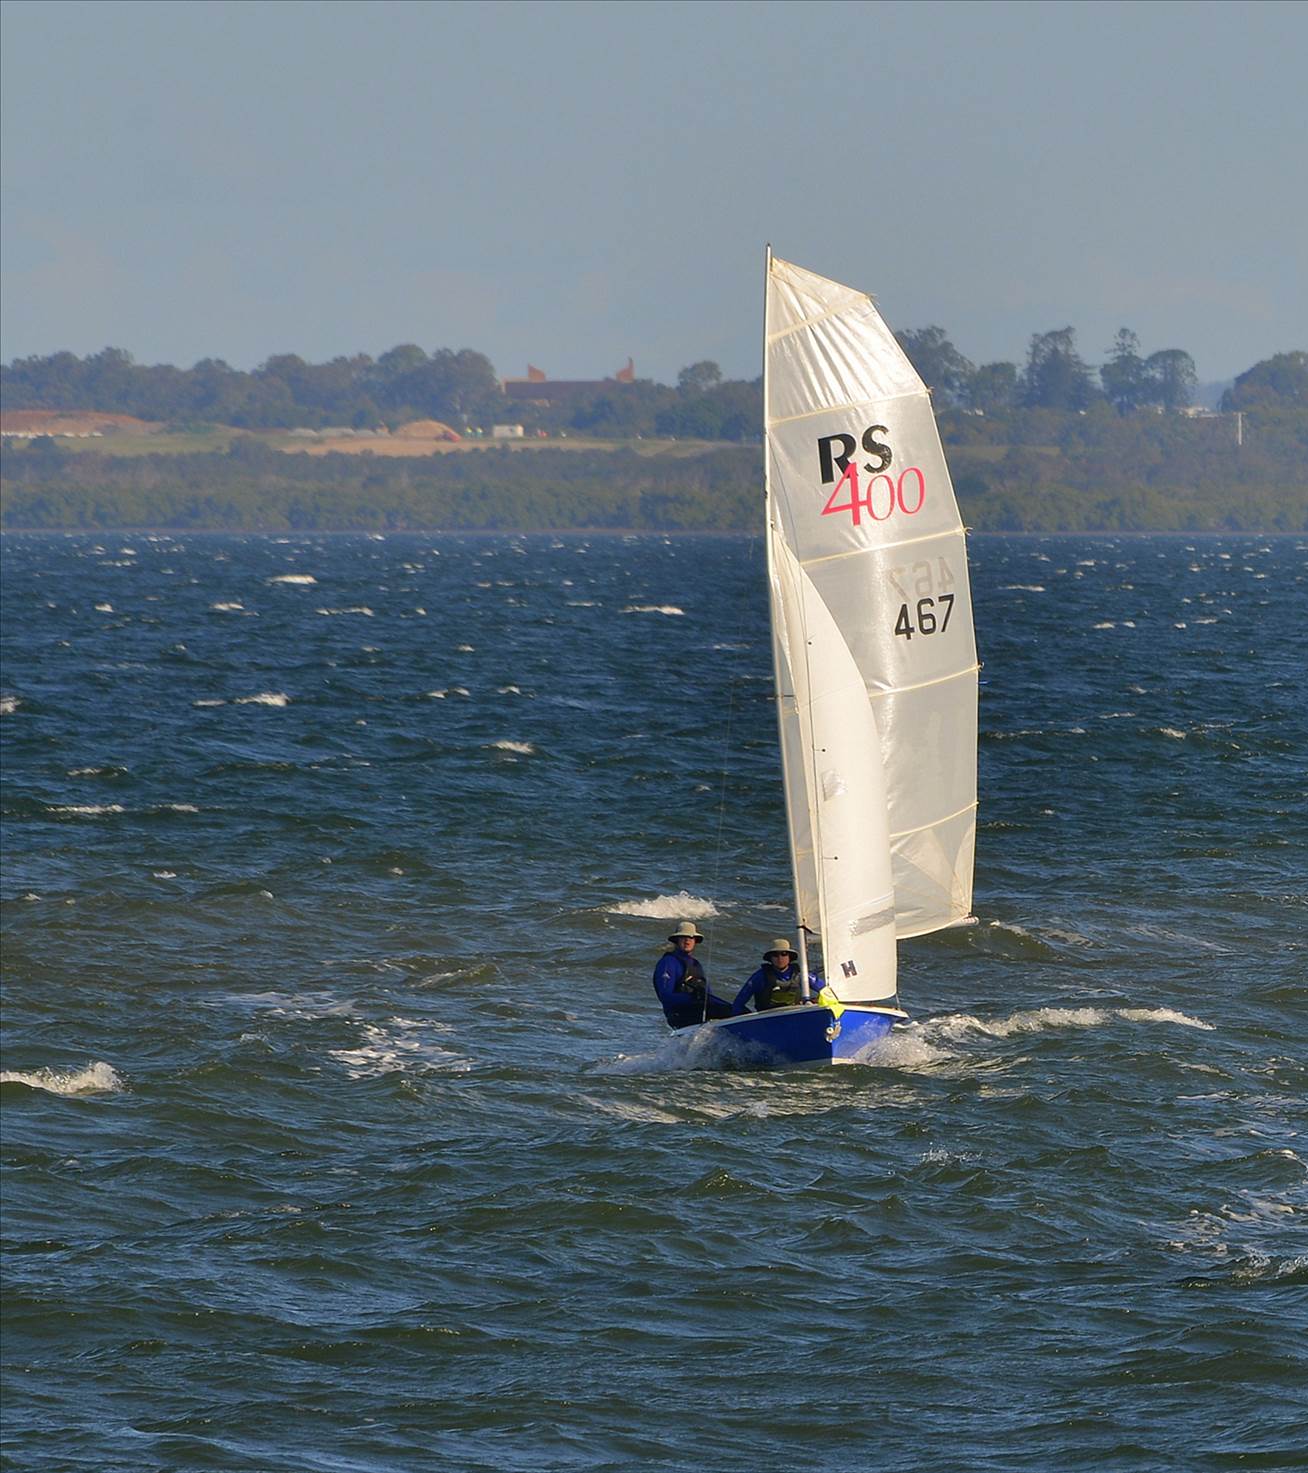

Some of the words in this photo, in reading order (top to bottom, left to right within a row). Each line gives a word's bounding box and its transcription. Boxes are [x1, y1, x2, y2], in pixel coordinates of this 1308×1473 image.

[817, 424, 893, 484] RS
[820, 462, 926, 526] 400
[894, 593, 955, 640] 467
